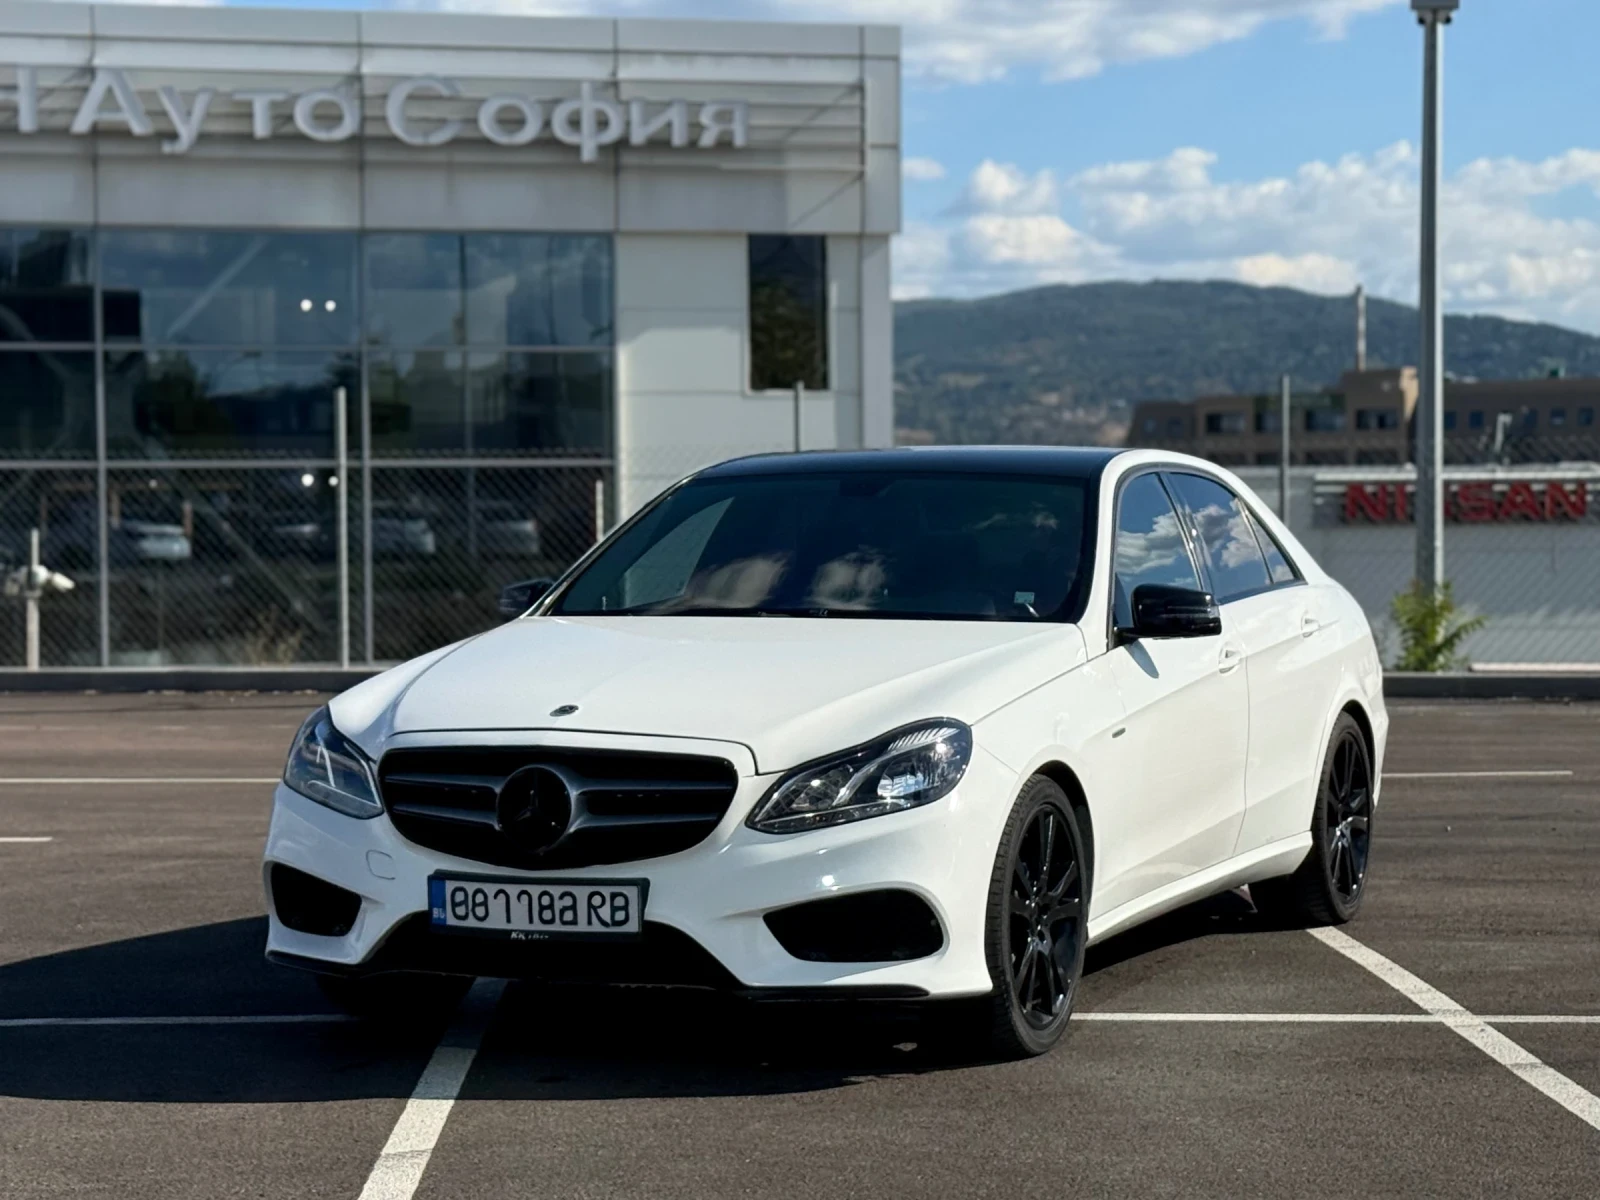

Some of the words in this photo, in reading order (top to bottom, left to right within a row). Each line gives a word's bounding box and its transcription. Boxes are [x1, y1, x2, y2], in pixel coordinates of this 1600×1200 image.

[70, 69, 361, 154] Ауто
[385, 76, 750, 163] София
[1344, 481, 1587, 521] NISAN
